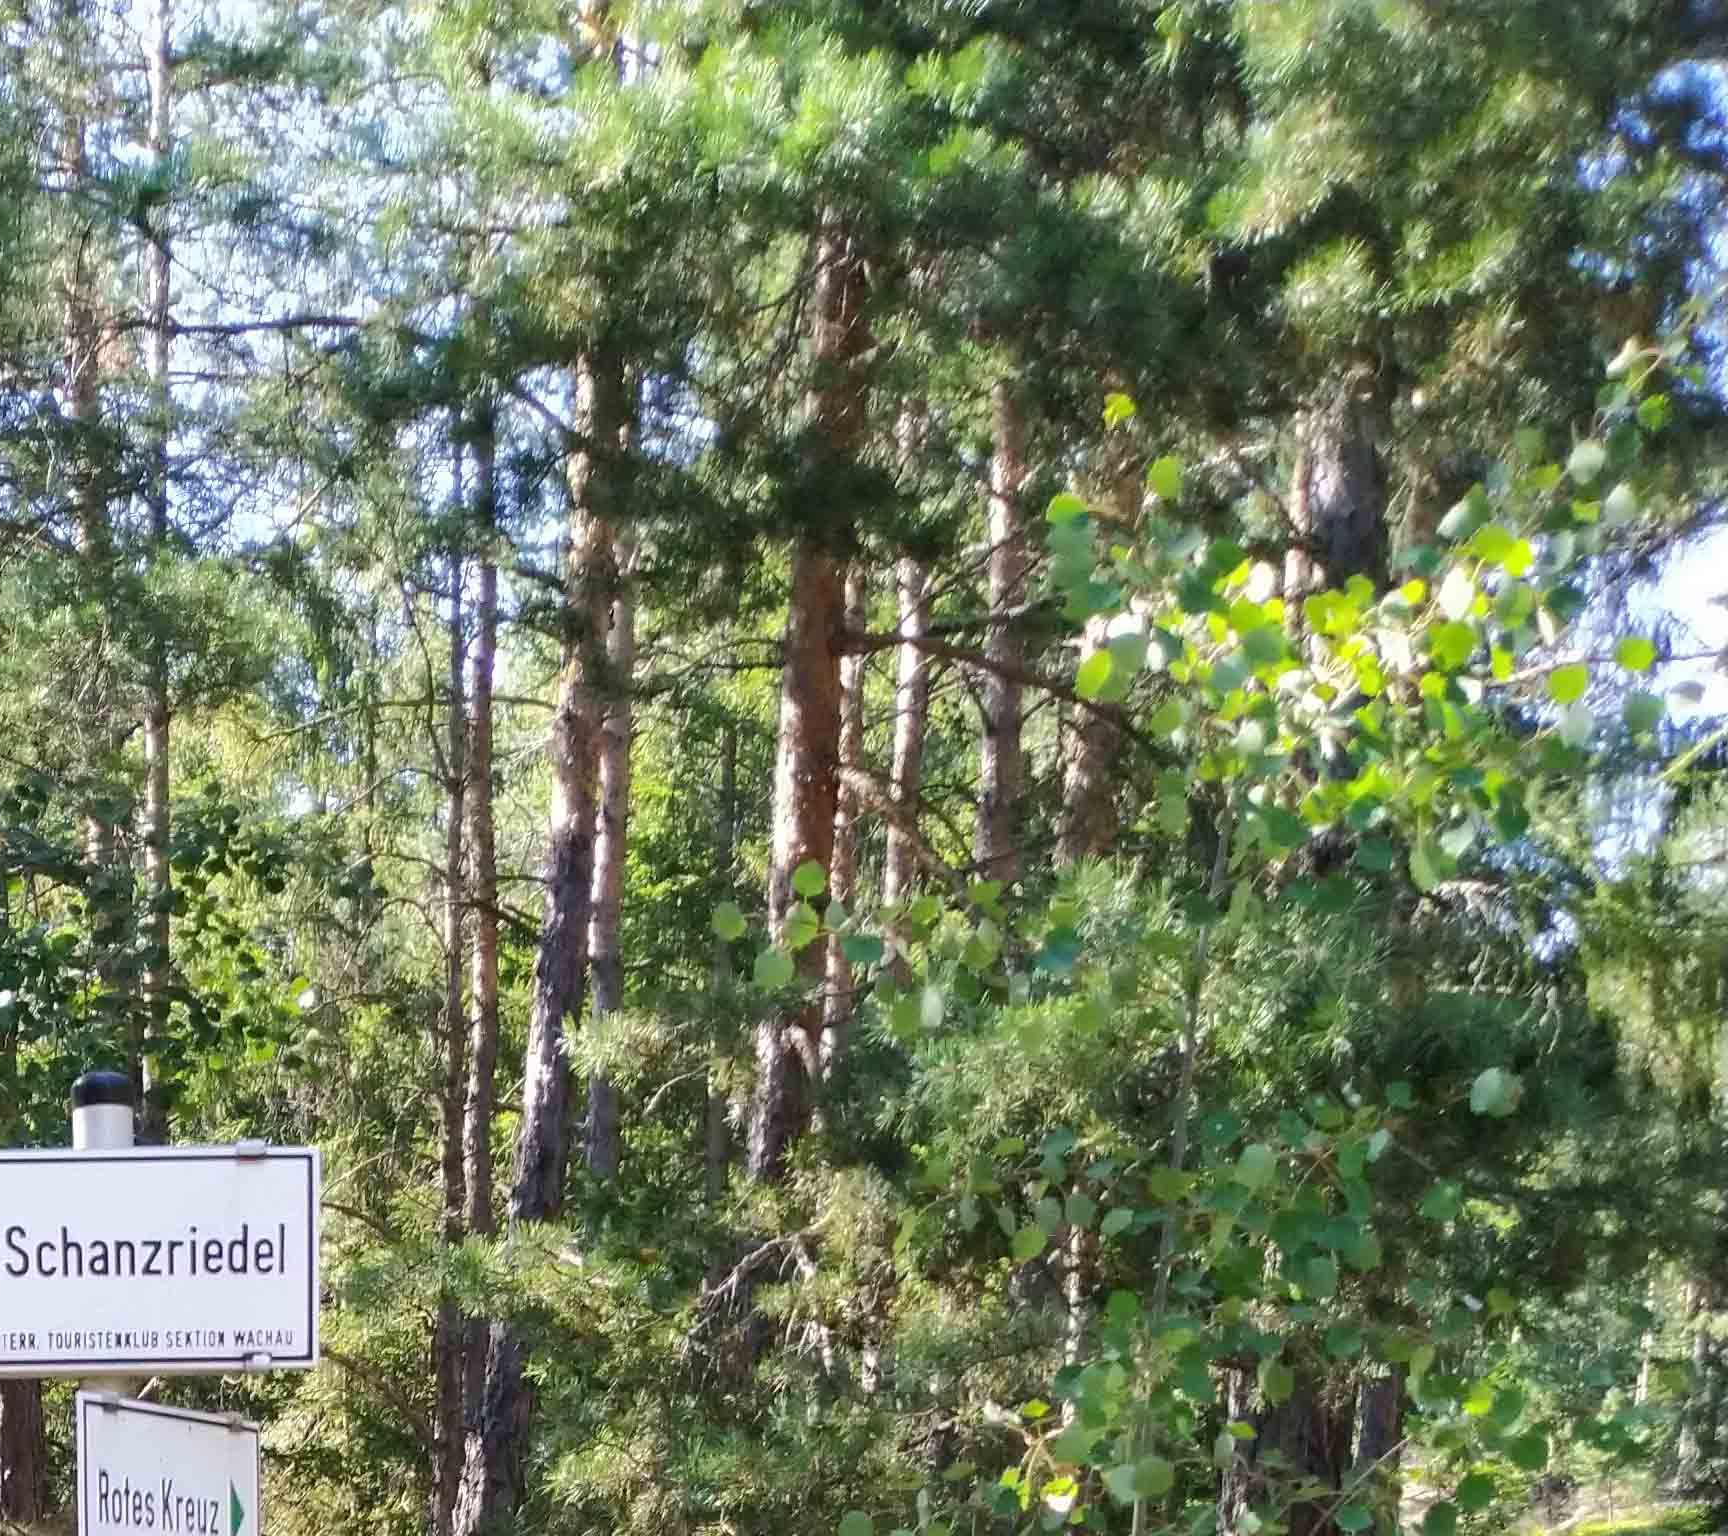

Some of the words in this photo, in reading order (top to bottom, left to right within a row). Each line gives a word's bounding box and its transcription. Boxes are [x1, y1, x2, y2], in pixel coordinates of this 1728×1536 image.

[4, 1223, 286, 1277] Schanzriedel
[48, 1330, 159, 1350] TOURISTENKLUB
[165, 1330, 225, 1348] SEKTION
[233, 1329, 293, 1347] WACHAU
[98, 1468, 155, 1527] Rotes
[161, 1478, 220, 1536] Kreuz
